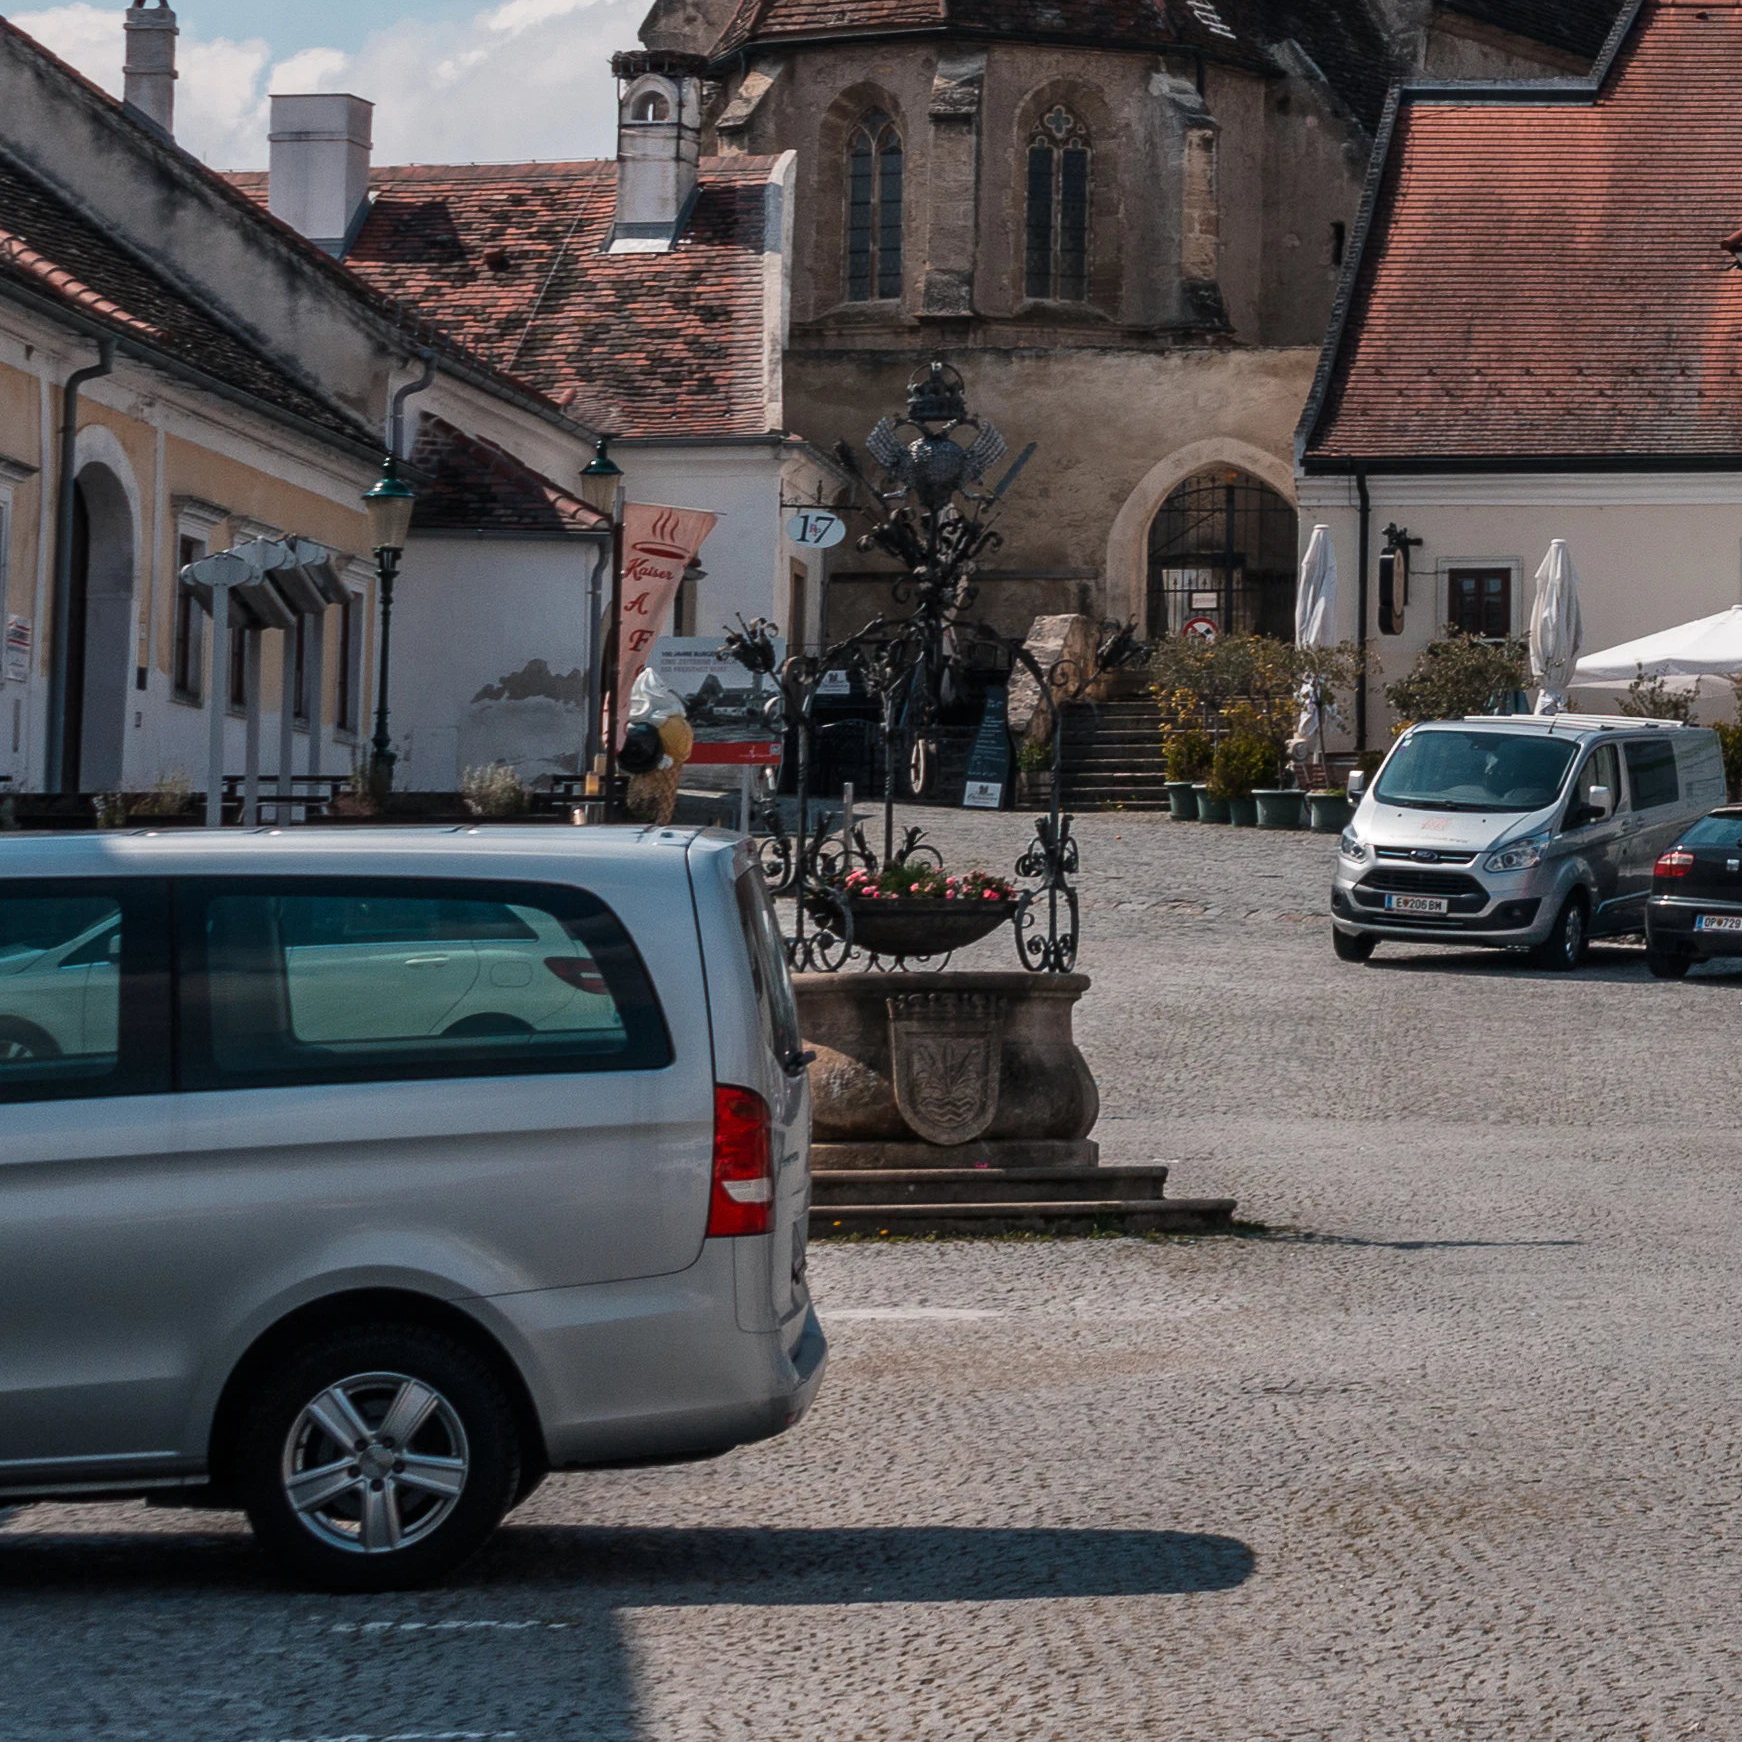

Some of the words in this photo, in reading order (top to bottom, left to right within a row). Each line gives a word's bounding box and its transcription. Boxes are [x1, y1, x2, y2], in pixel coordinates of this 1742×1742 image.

[796, 514, 837, 545] 17
[622, 558, 674, 581] Kaiser
[1396, 898, 1403, 908] E
[1408, 898, 1428, 910] 206
[1722, 918, 1742, 929] 729
